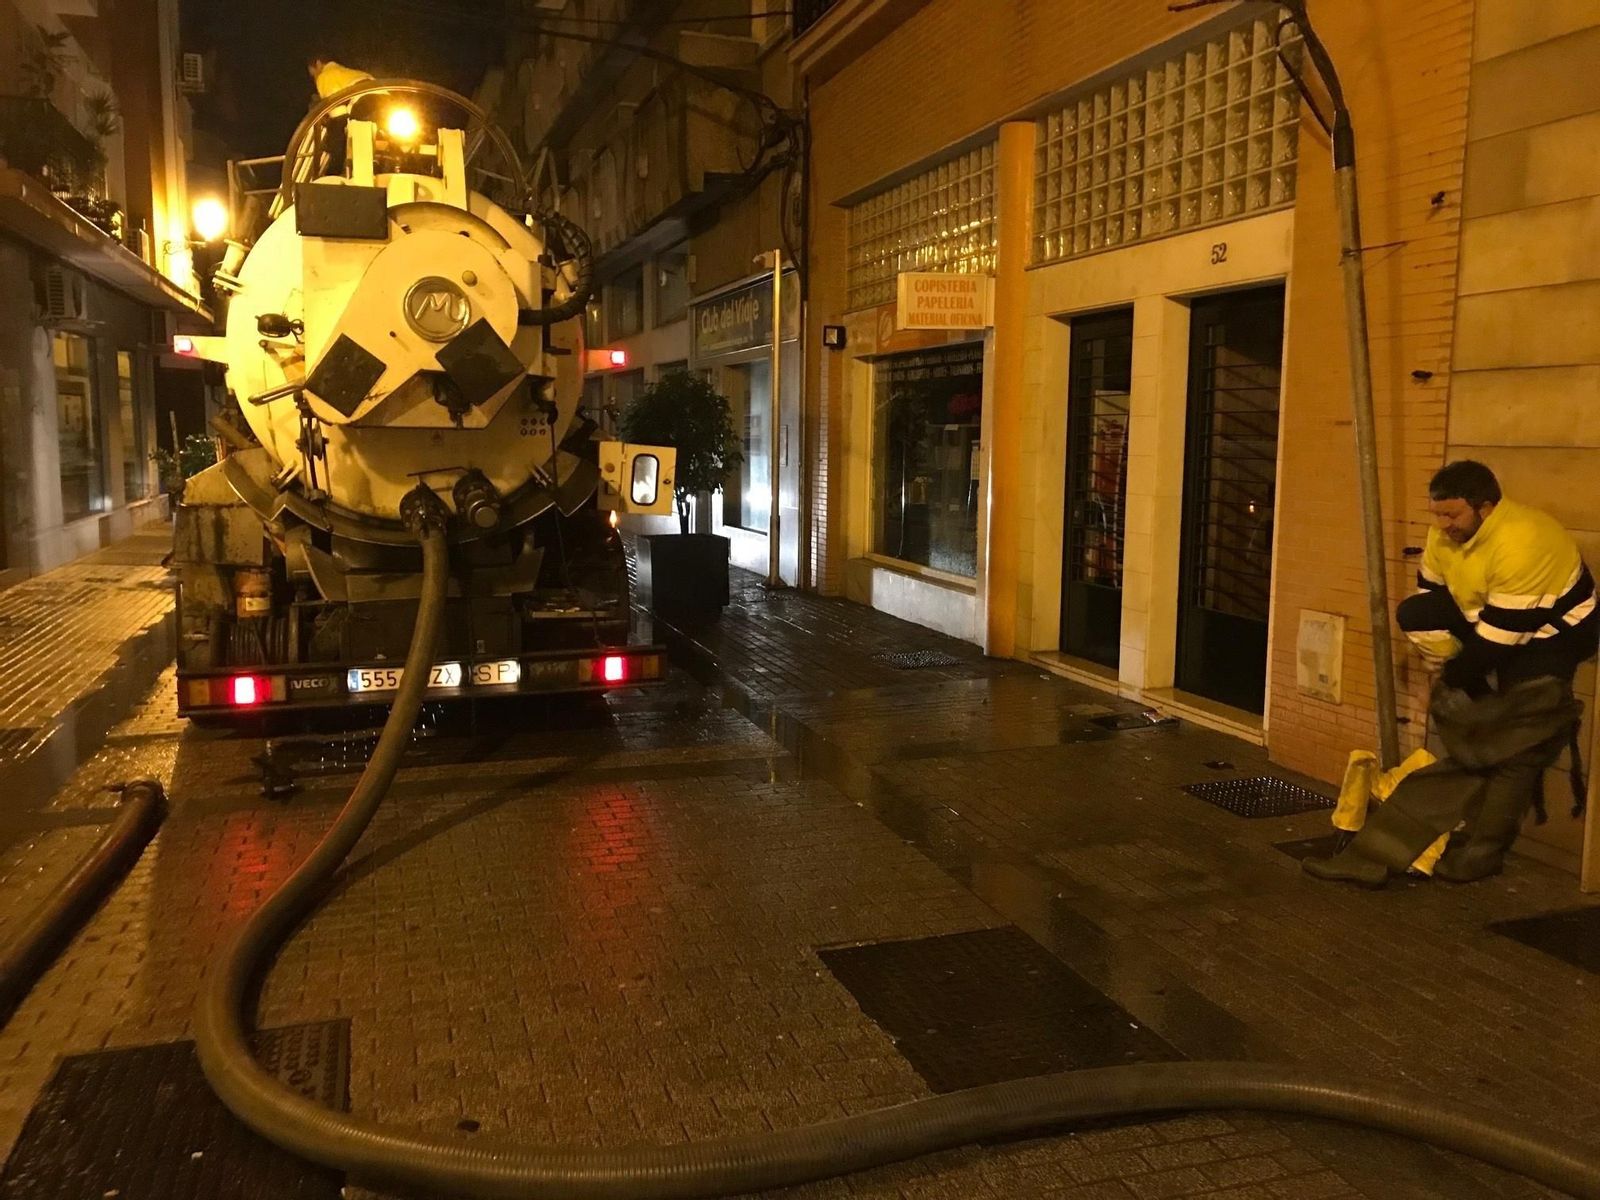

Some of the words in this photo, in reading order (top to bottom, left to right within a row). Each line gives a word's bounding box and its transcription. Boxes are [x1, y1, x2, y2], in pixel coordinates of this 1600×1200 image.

[1211, 242, 1227, 265] 52
[701, 305, 719, 334] Club
[720, 299, 734, 329] del
[735, 295, 759, 324] Viaje
[908, 312, 947, 326] MATERIAL
[291, 678, 329, 689] IVECO
[361, 671, 400, 688] 555
